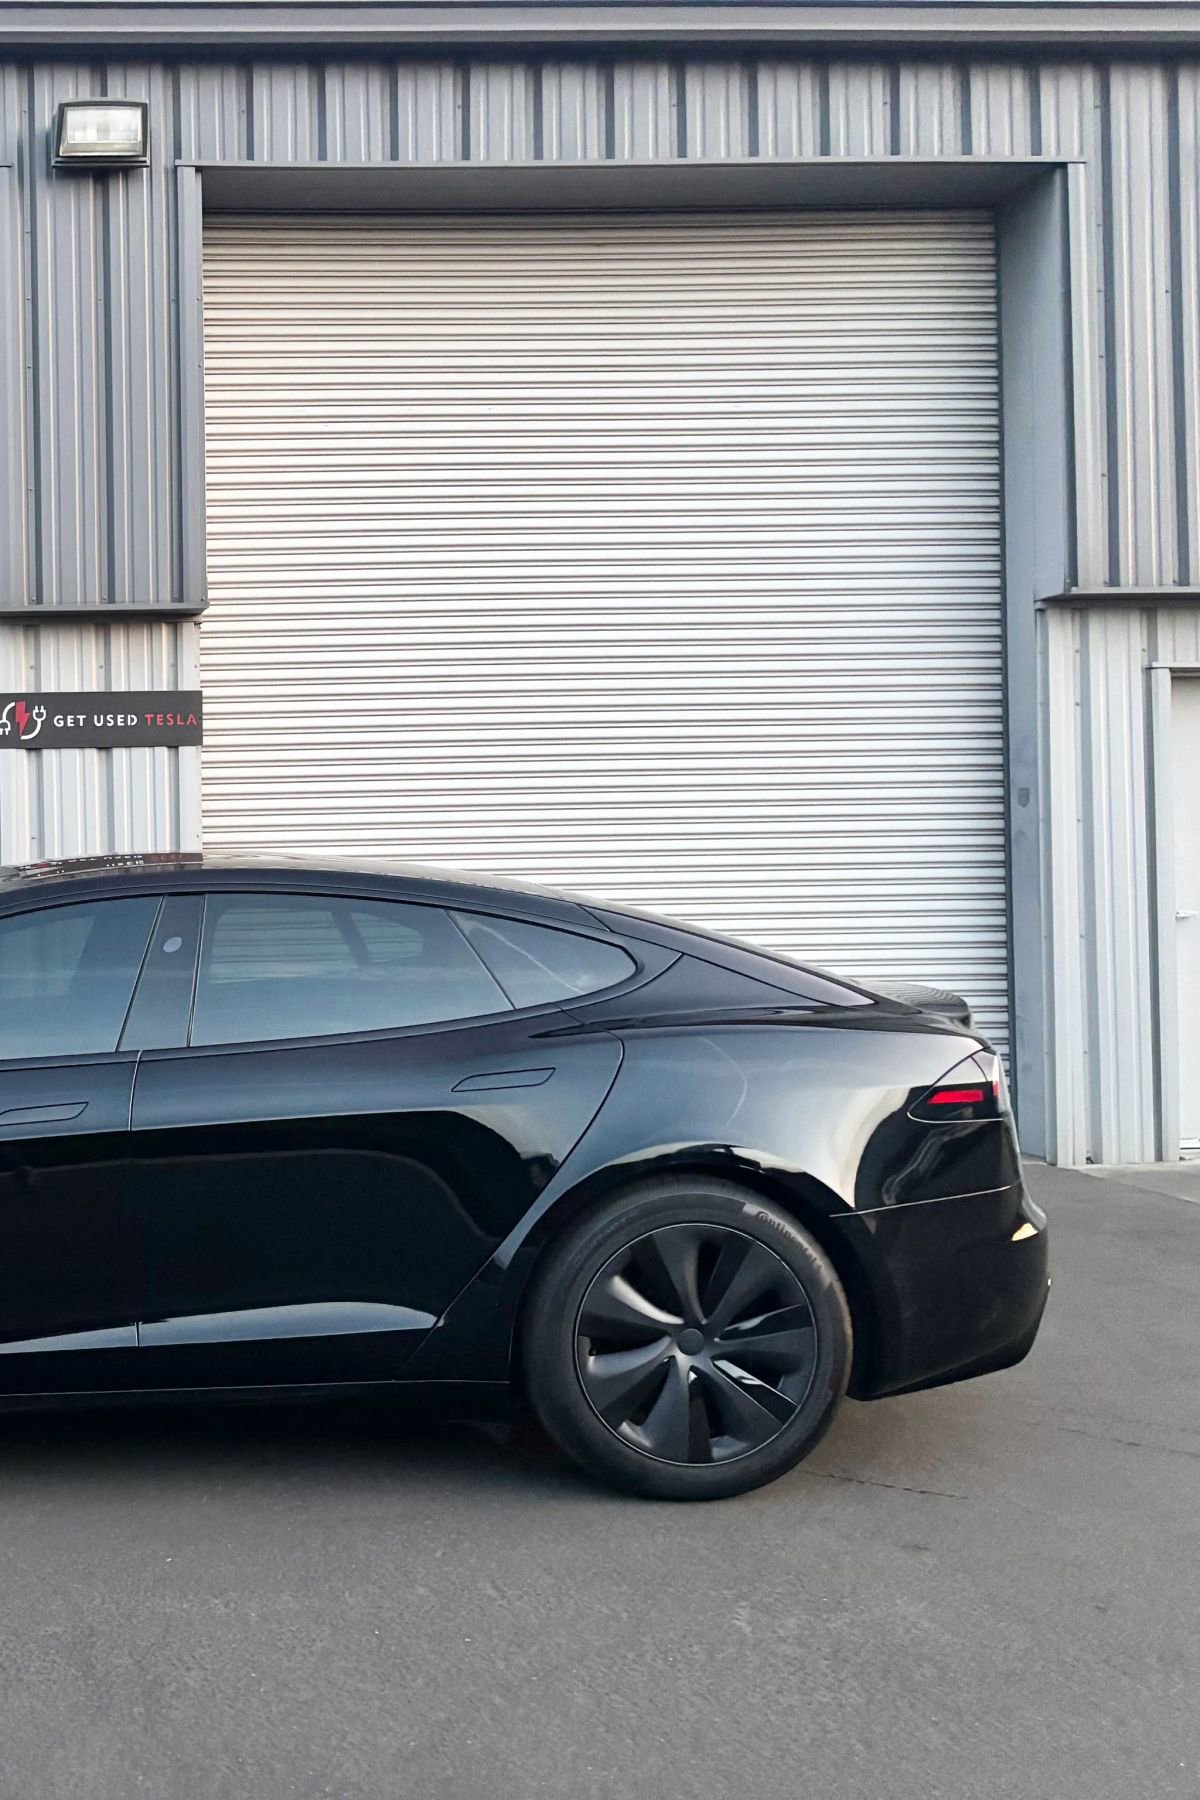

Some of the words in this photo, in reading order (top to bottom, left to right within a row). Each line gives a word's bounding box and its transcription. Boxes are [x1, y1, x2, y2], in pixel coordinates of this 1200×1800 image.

[53, 714, 87, 727] GET
[93, 713, 138, 727] USED
[145, 713, 198, 726] TESLA
